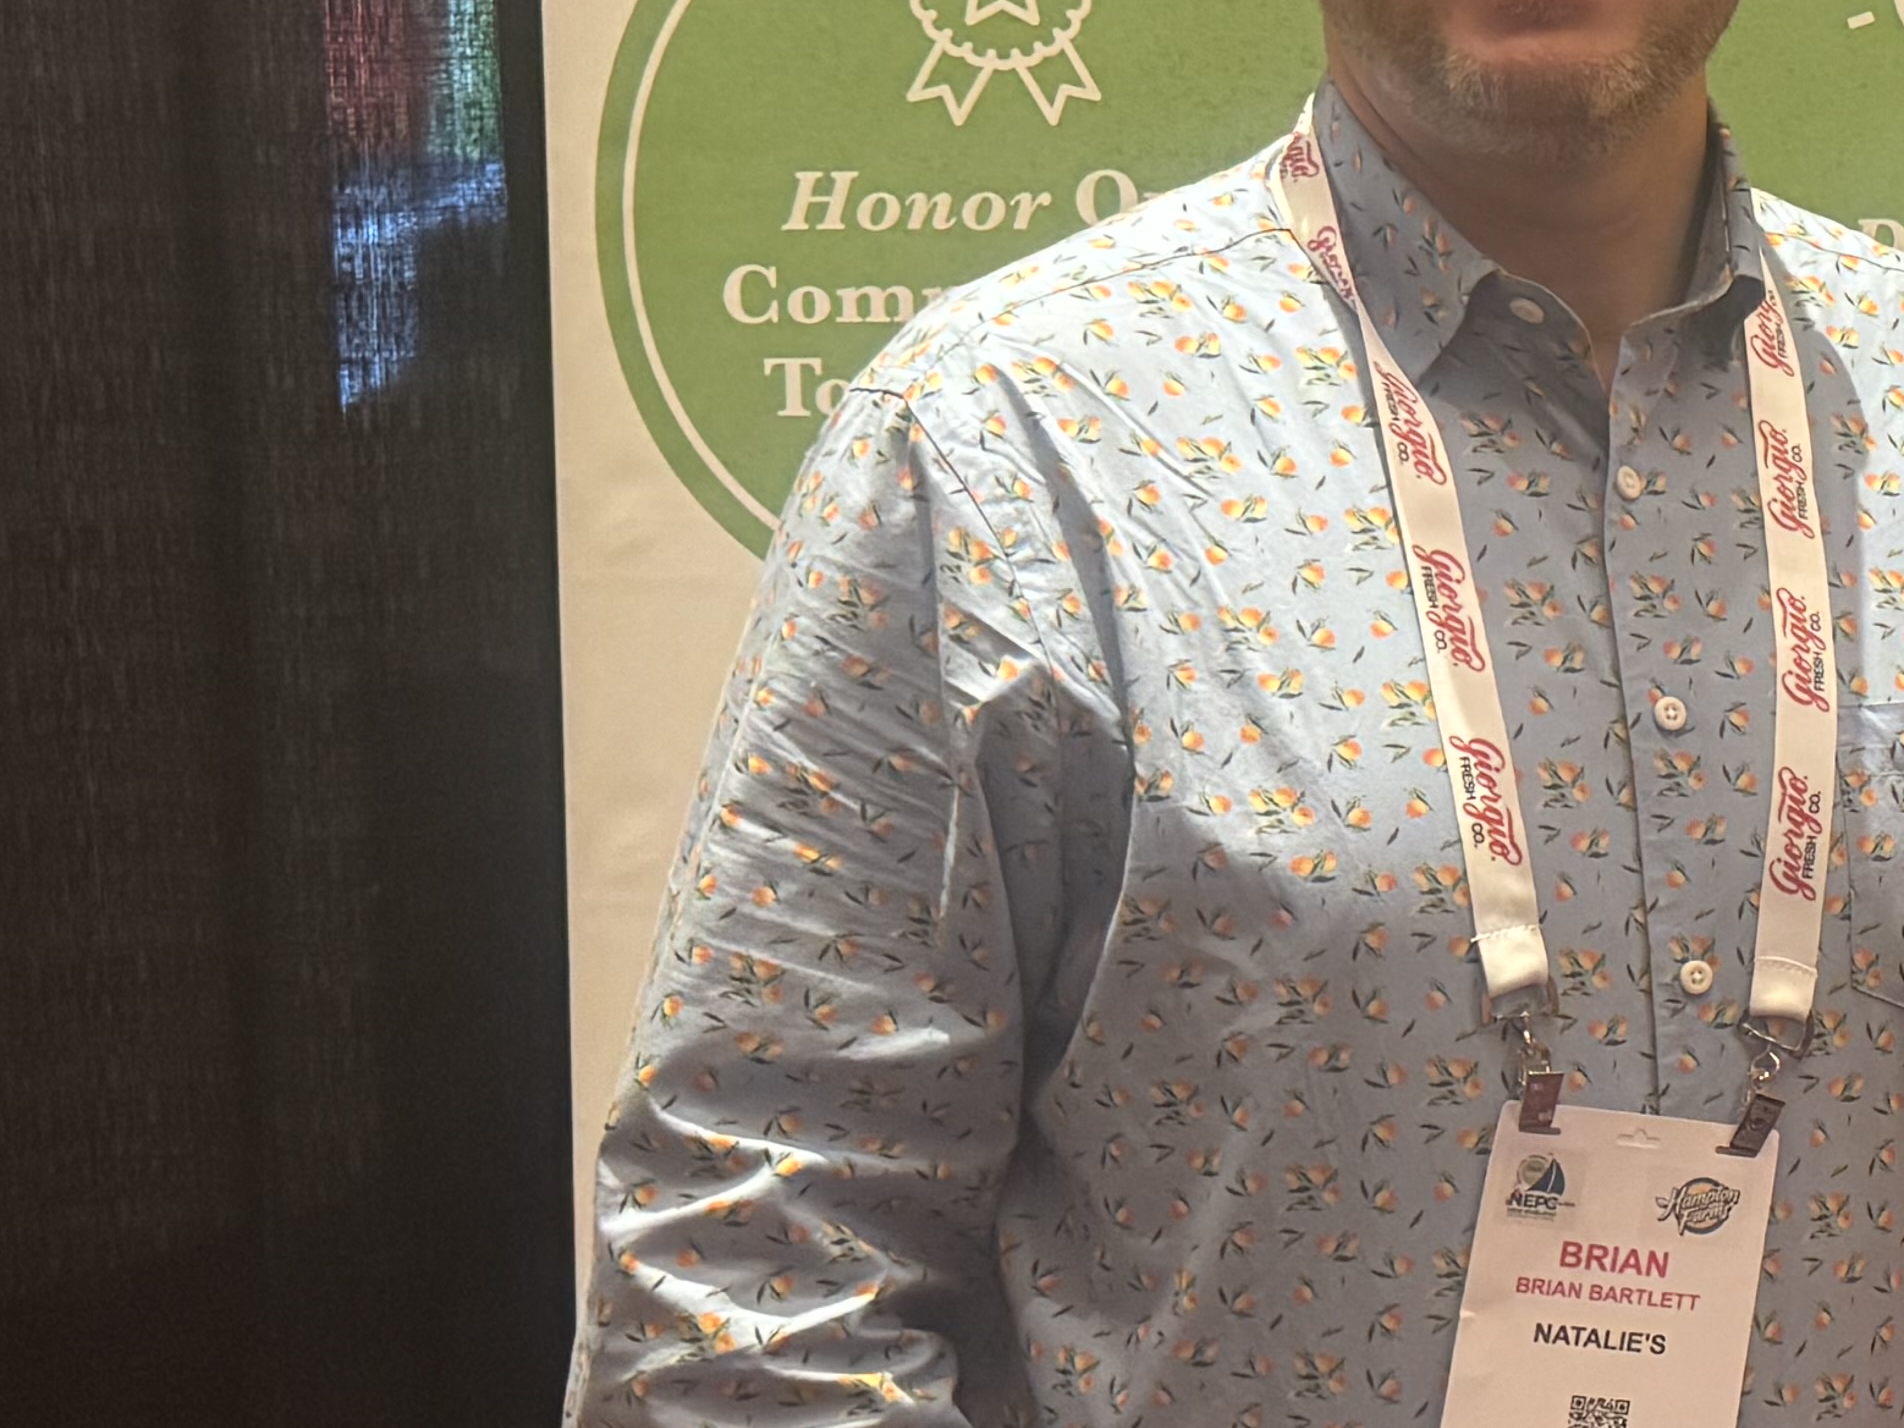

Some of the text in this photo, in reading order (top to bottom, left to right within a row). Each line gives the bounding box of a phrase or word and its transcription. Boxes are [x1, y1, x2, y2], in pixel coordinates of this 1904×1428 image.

[780, 170, 1051, 232] Honor
[1421, 565, 1439, 610] FRESH
[1813, 650, 1826, 693] FRESH
[1459, 756, 1486, 849] FRESH CO.
[1801, 790, 1822, 880] FRESH CO.
[1559, 1241, 1670, 1279] BRIAN
[1515, 1276, 1701, 1312] BRIAN BARTLETT
[1533, 1322, 1667, 1355] NATALIE'S
